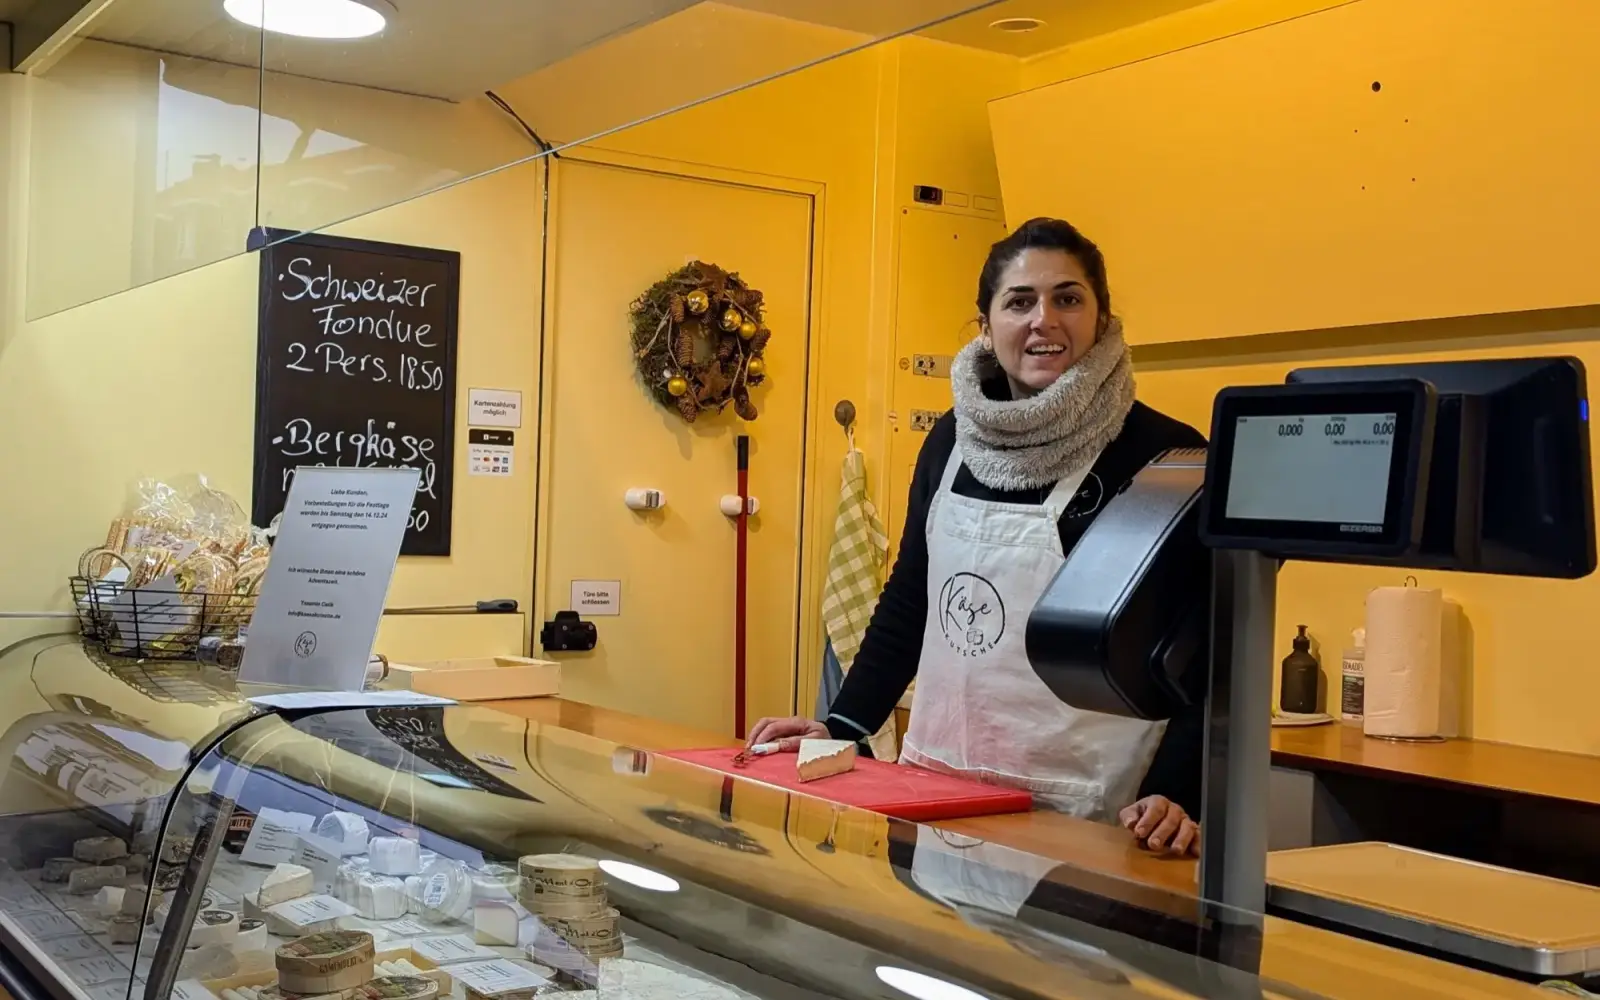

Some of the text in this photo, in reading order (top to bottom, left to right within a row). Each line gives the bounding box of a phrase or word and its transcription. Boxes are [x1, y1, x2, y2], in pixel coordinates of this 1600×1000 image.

[312, 303, 438, 348] Fondue
[286, 342, 314, 372] 2
[315, 342, 392, 383] Pers.
[473, 399, 516, 409] Kartenzahlung
[483, 408, 507, 416] möglich
[304, 500, 347, 508] Vorbestellungen
[946, 577, 992, 631] Käse
[945, 633, 994, 657] KUTSCHE
